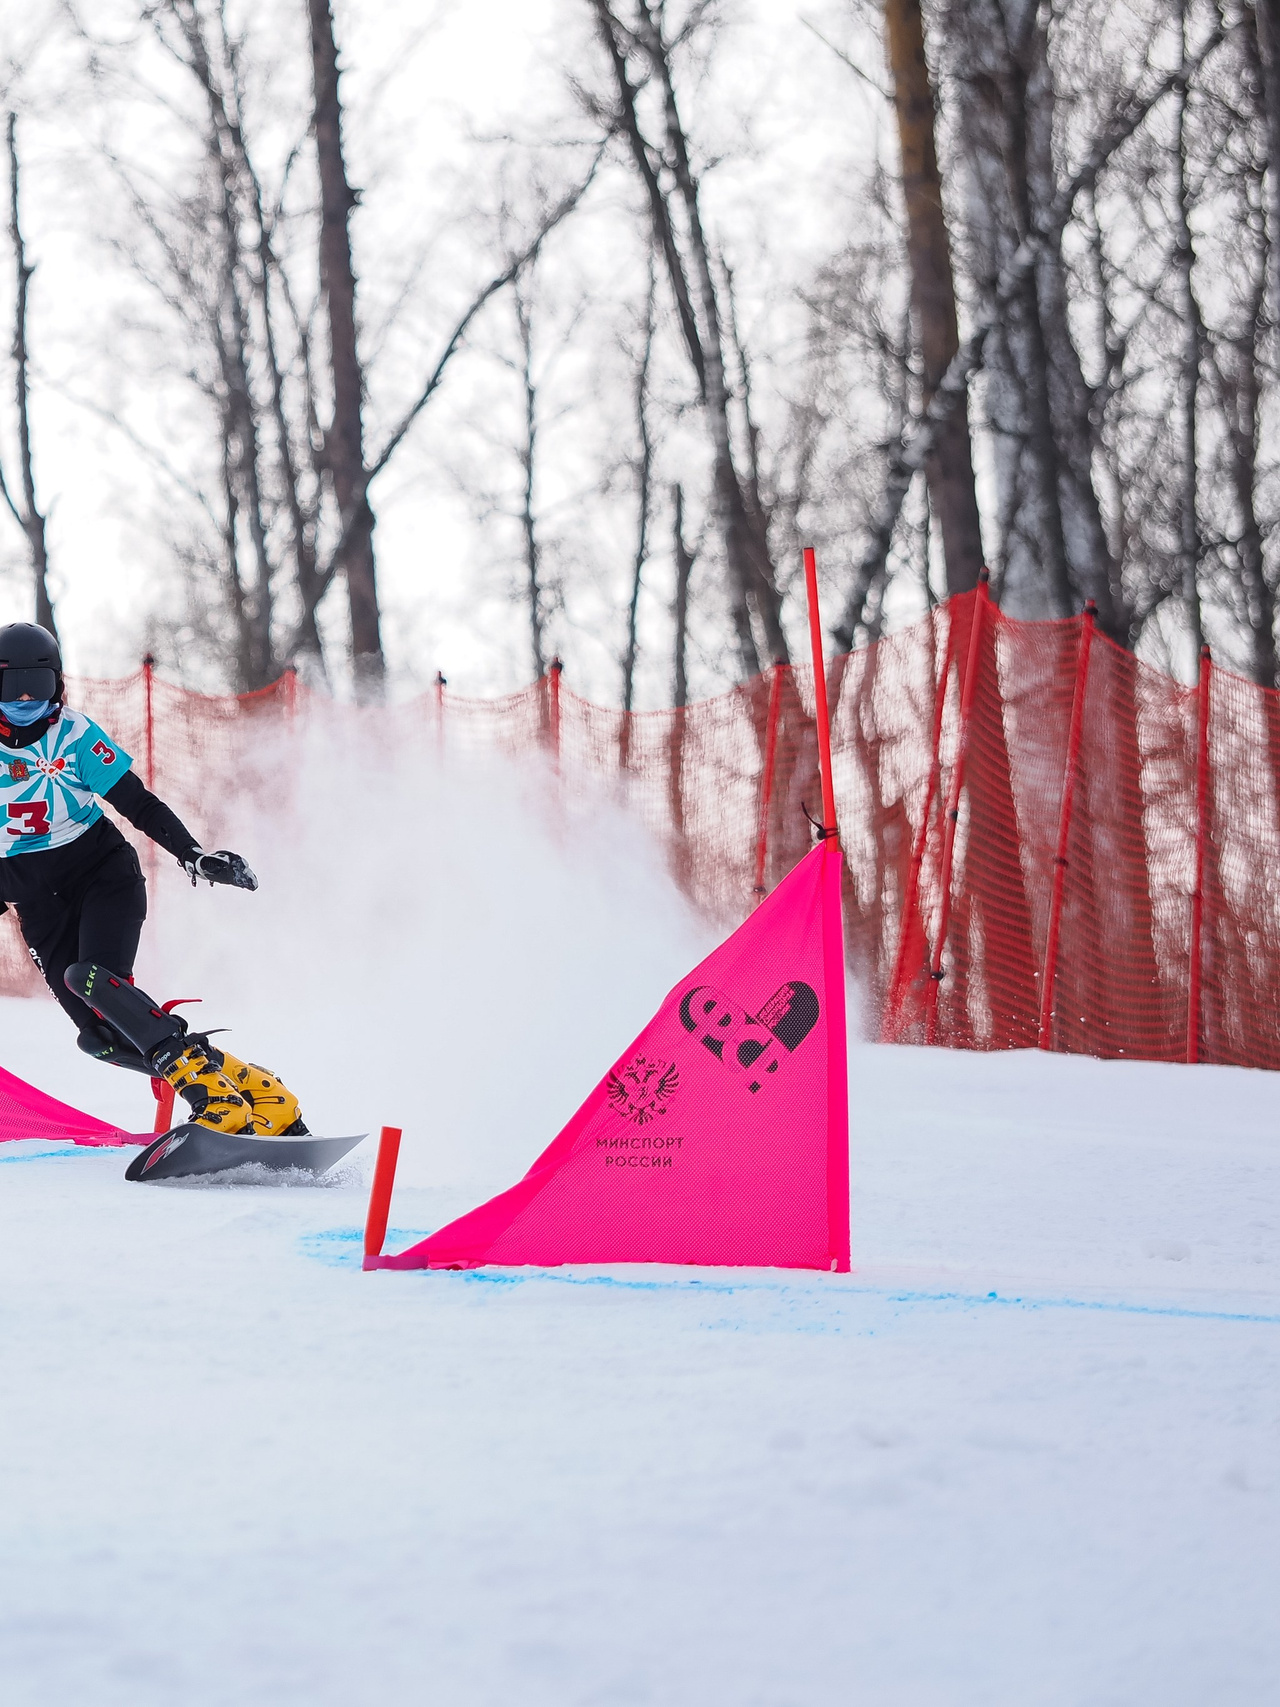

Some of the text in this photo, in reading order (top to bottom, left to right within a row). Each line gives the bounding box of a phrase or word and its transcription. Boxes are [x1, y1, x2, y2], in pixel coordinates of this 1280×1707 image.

[91, 740, 117, 765] 3
[7, 800, 51, 835] 3
[84, 965, 98, 996] LEKI
[595, 1137, 684, 1149] МИНСПОРТ
[605, 1156, 672, 1168] РОССИИ
